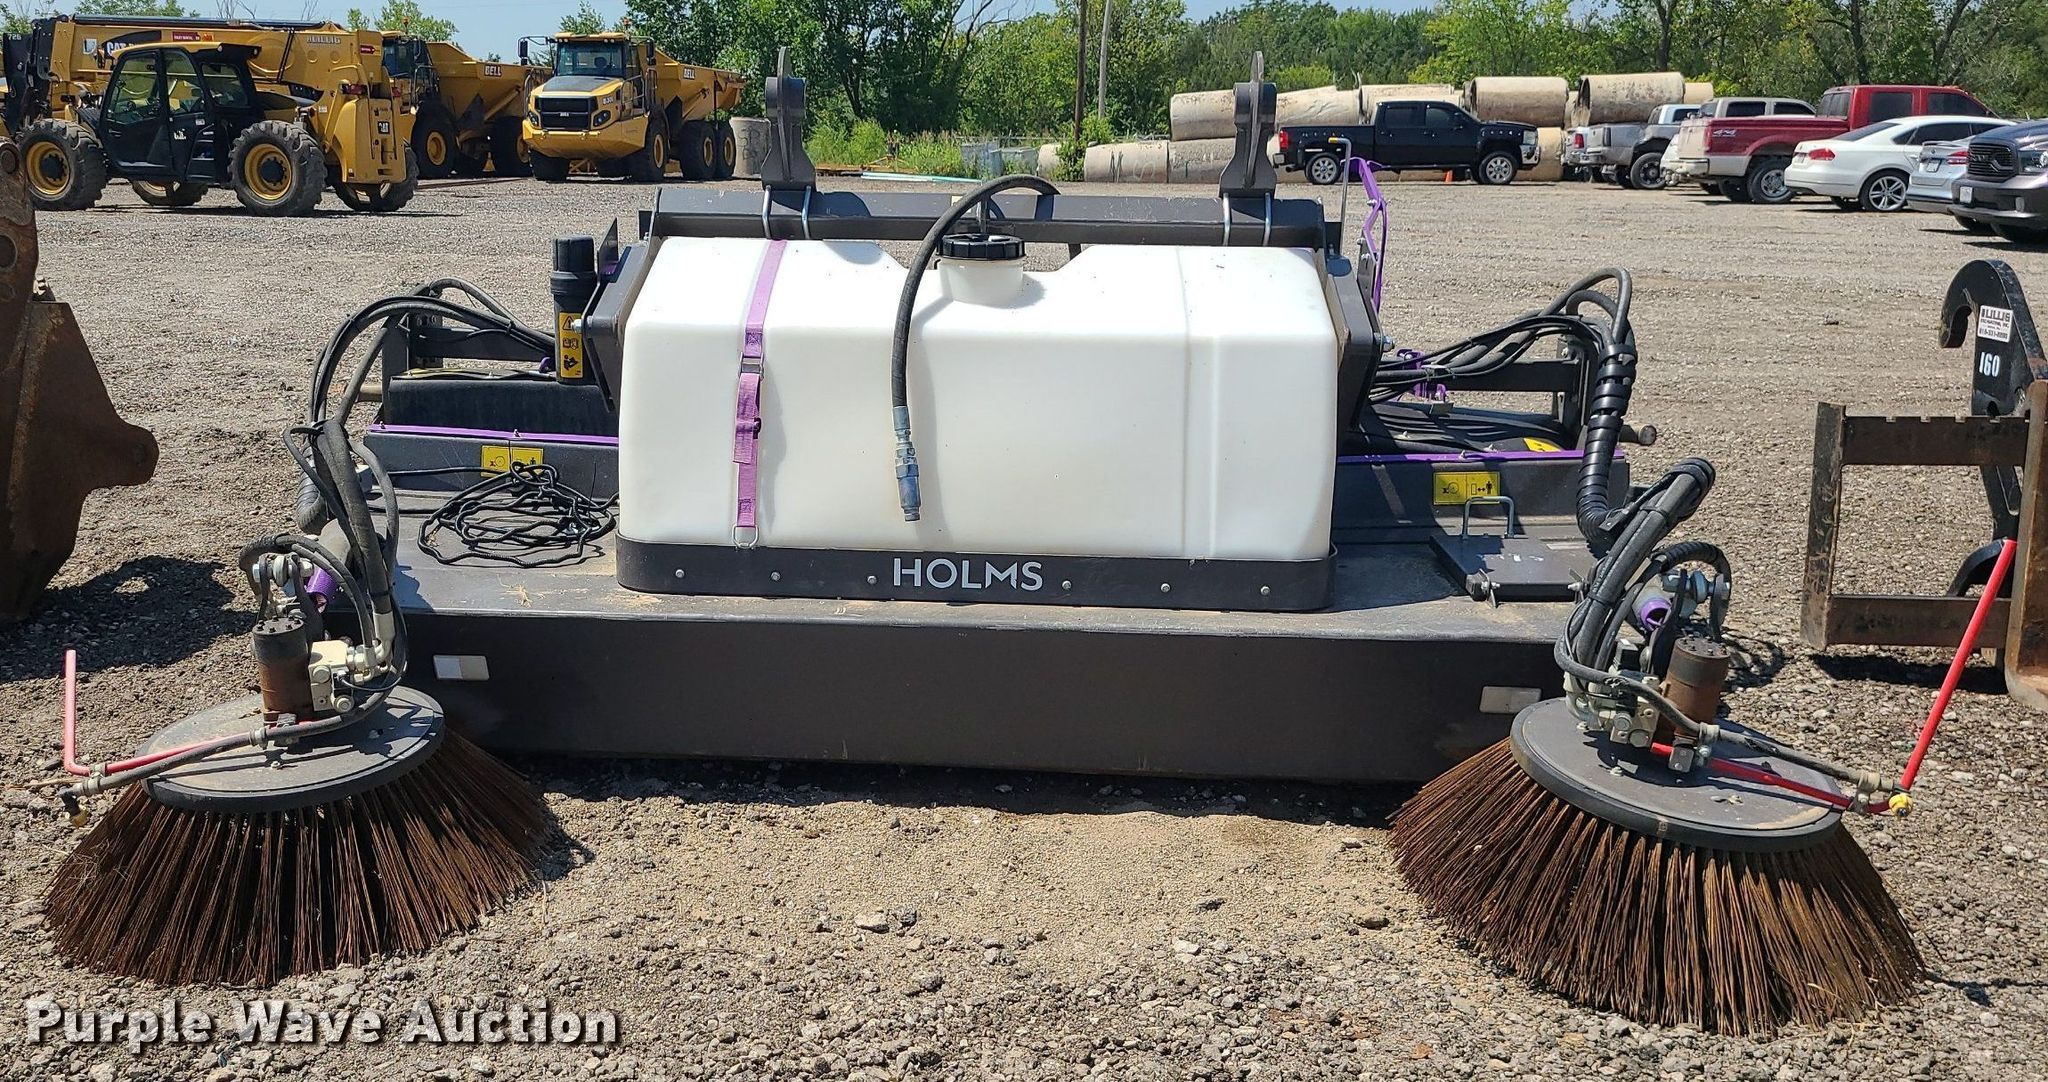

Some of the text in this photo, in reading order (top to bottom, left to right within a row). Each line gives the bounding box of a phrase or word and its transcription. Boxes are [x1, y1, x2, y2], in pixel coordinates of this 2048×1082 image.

[485, 65, 502, 76] BELL
[1979, 352, 2000, 377] 160
[893, 557, 1043, 591] HOLMS
